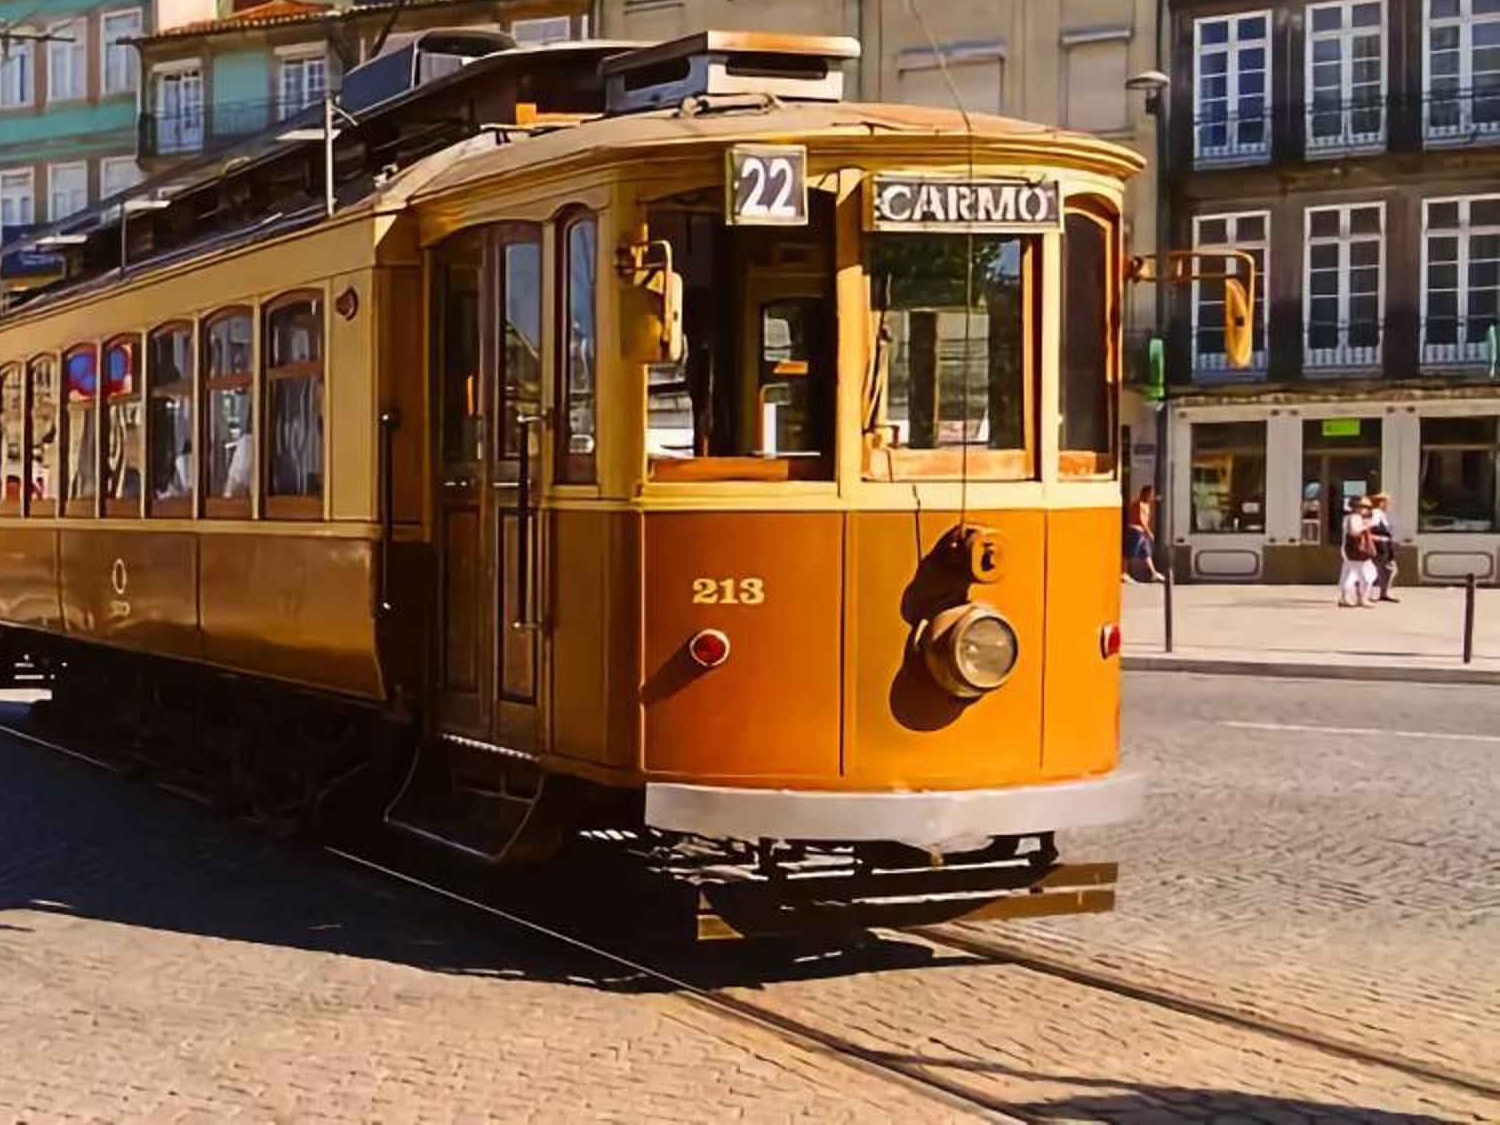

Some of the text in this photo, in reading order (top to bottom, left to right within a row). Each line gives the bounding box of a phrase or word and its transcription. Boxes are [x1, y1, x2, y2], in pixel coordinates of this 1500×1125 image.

[740, 157, 797, 217] 22
[880, 184, 1049, 222] CARMO
[692, 578, 765, 604] 213
